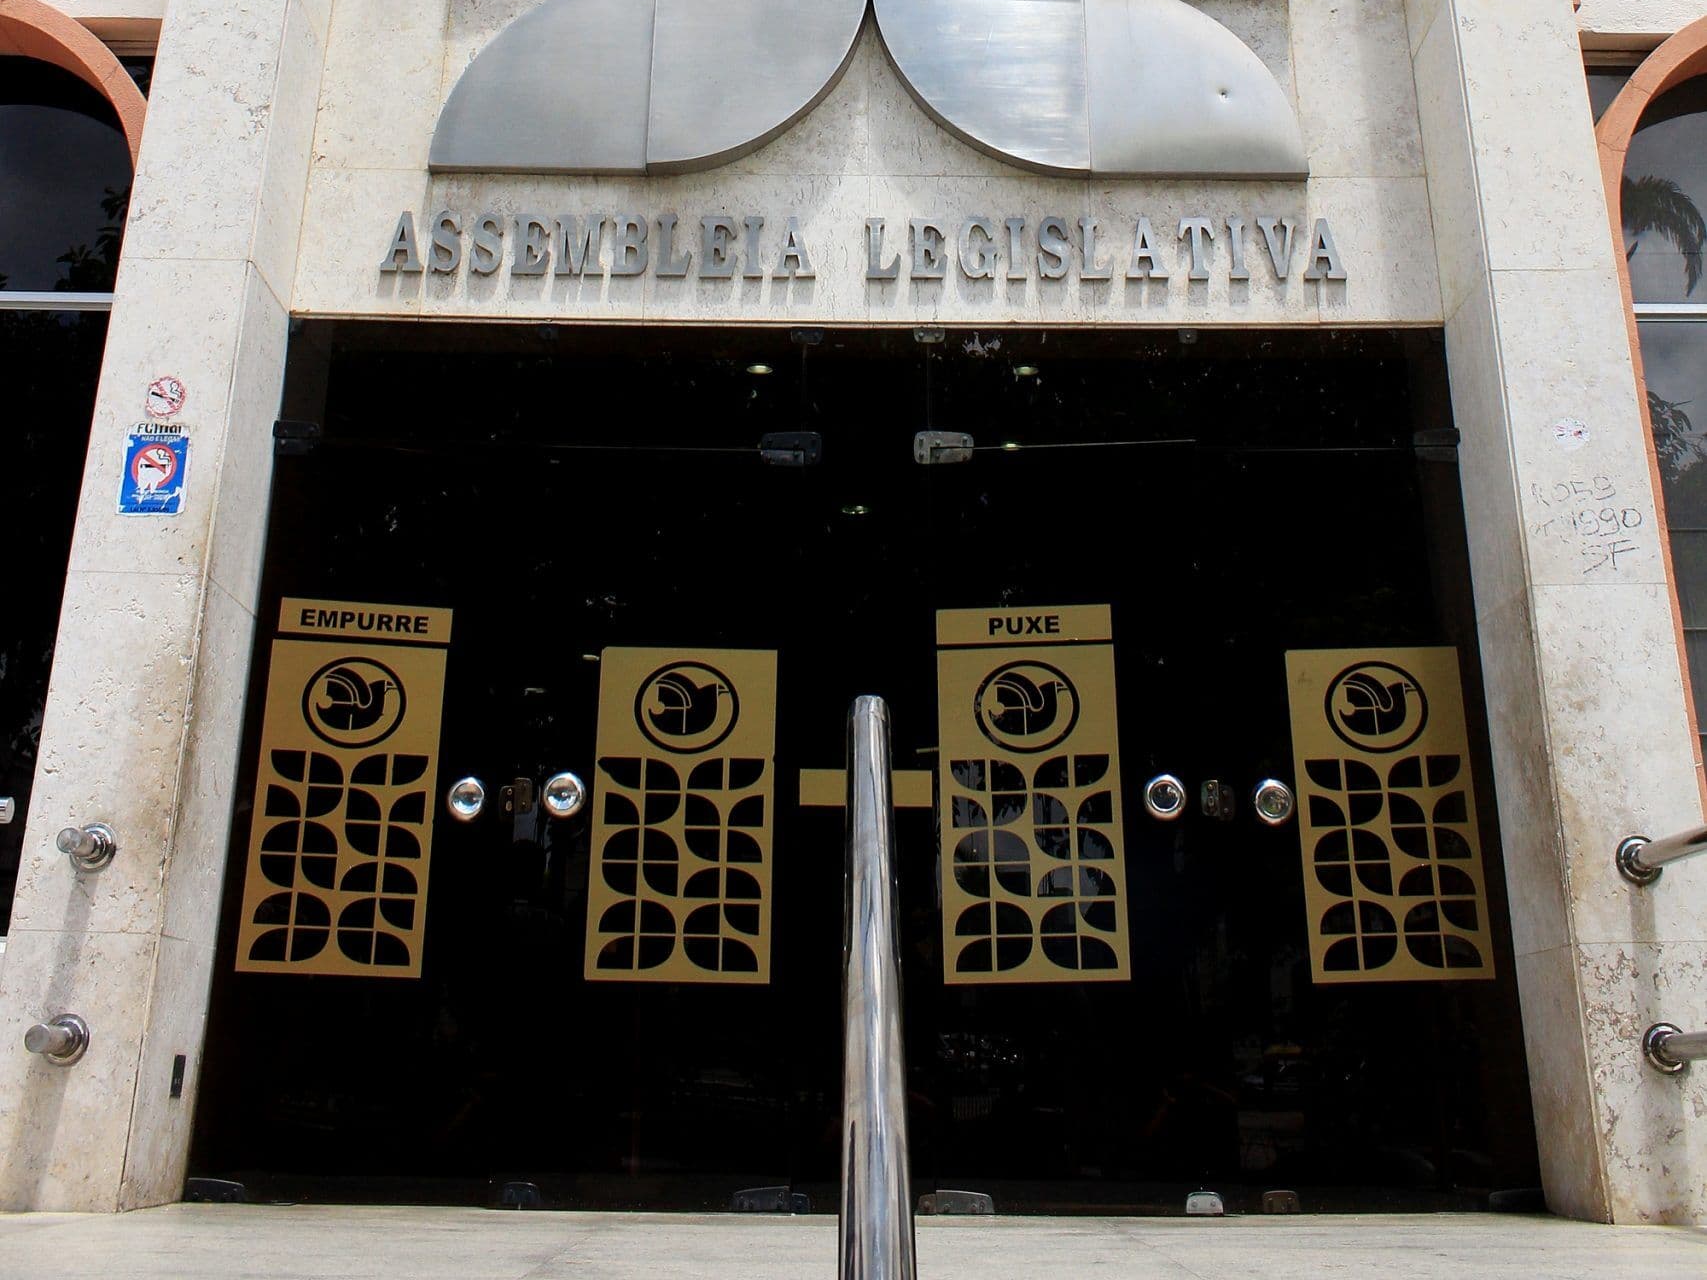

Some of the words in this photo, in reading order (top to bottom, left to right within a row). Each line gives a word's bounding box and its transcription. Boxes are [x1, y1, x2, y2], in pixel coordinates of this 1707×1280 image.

[380, 210, 816, 280] ASSEMBLEIA
[865, 216, 1347, 281] LEGISLATIVA
[300, 608, 430, 634] EMPURRE
[988, 615, 1060, 636] PUXE
